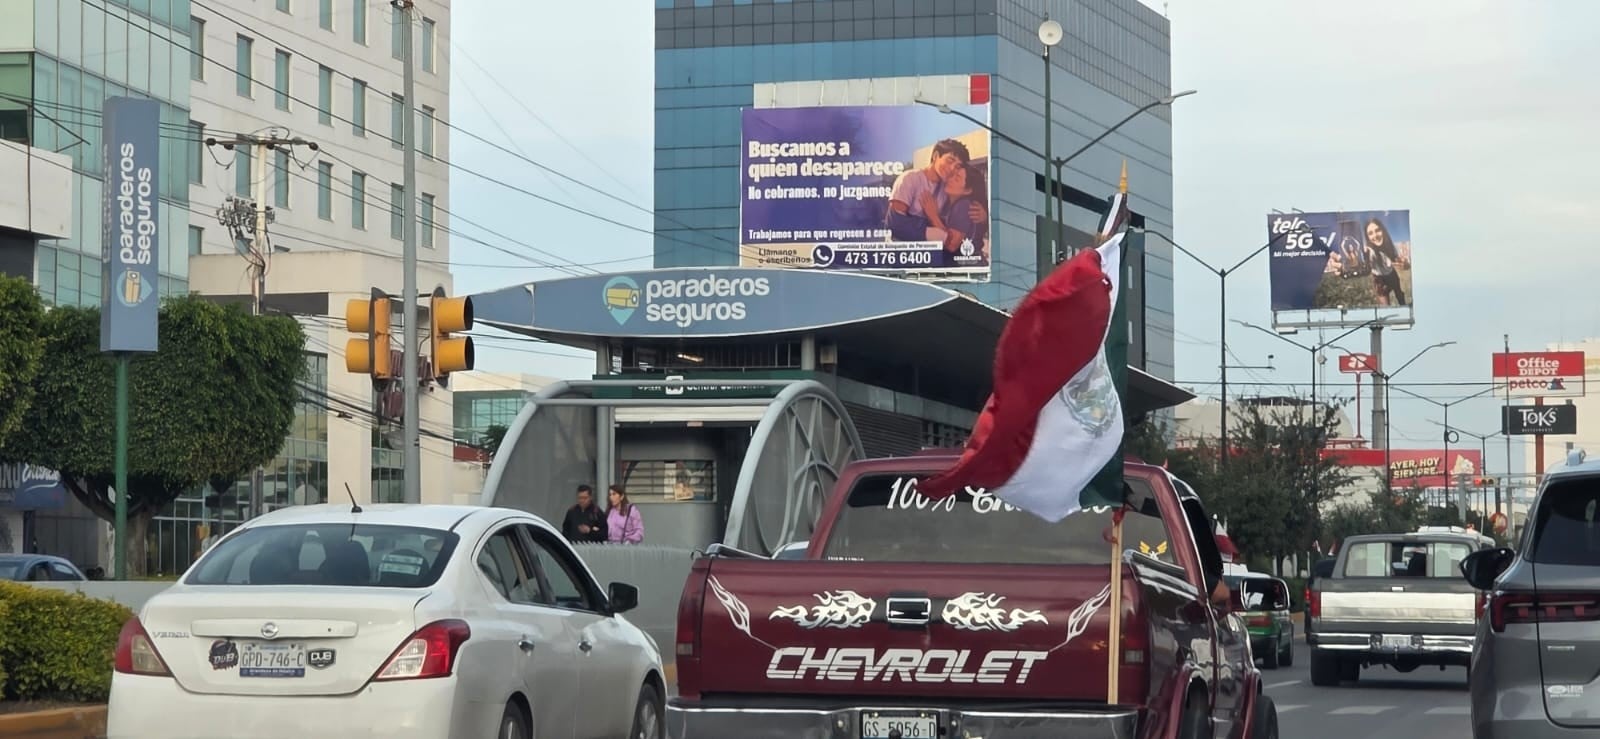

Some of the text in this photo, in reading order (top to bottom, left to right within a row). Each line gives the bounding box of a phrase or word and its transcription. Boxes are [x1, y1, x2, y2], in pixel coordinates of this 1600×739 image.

[749, 141, 850, 158] Buscamos a
[749, 158, 904, 182] quien desaparece
[748, 186, 762, 200] No
[824, 186, 837, 199] no
[117, 143, 137, 264] paraderos
[137, 167, 155, 265] seguros
[749, 229, 792, 241] Trabajamos
[793, 230, 811, 241] para
[813, 230, 827, 241] que
[830, 229, 864, 240] regresen
[866, 230, 872, 238] a
[1285, 232, 1313, 250] 5G
[845, 251, 931, 265] 473 176 6400
[646, 274, 770, 304] paraderos
[646, 302, 746, 328] seguros
[1517, 357, 1560, 368] Office
[1518, 368, 1558, 376] DEPOT
[1509, 378, 1548, 391] petco
[1420, 457, 1440, 467] HOY
[242, 651, 304, 667] GPD-746-C
[311, 651, 332, 661] DUB
[766, 647, 1049, 684] CHEVROLET
